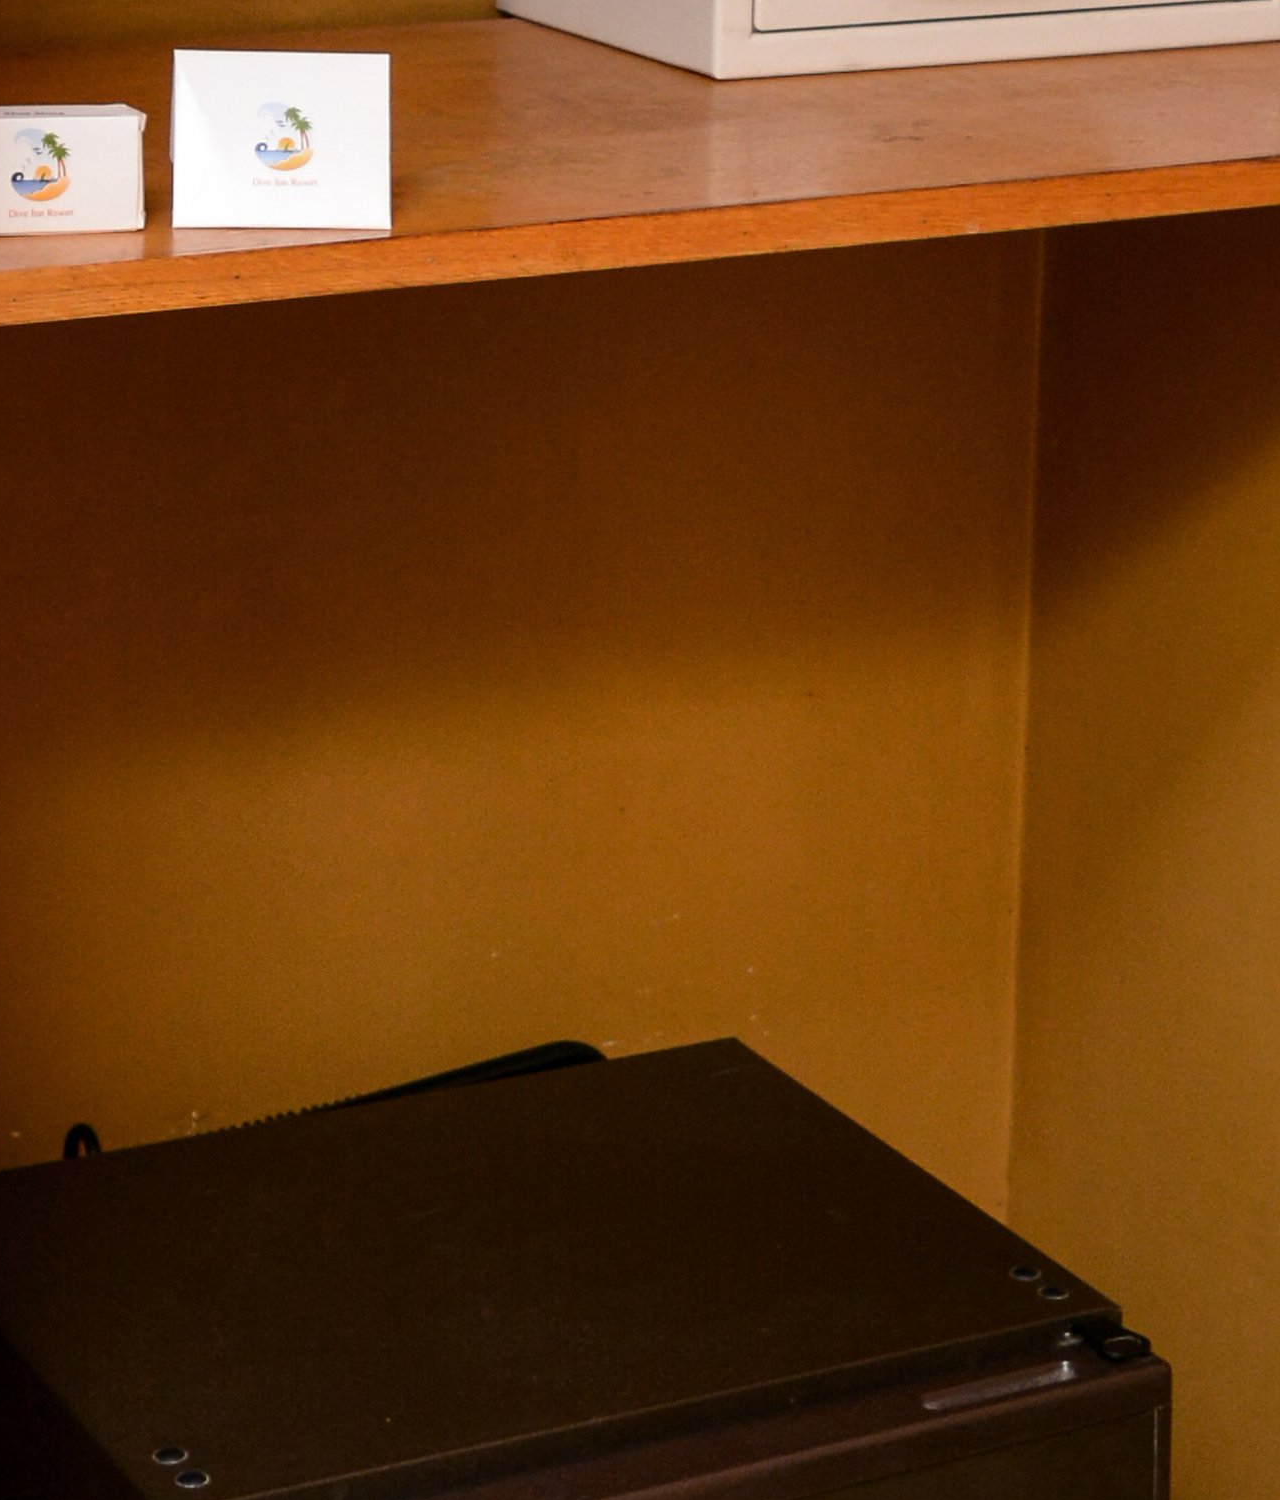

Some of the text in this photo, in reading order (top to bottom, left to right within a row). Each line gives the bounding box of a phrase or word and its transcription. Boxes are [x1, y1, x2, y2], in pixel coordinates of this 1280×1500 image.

[252, 178, 272, 186] Dive
[8, 208, 73, 218] Dive Inn Resort
